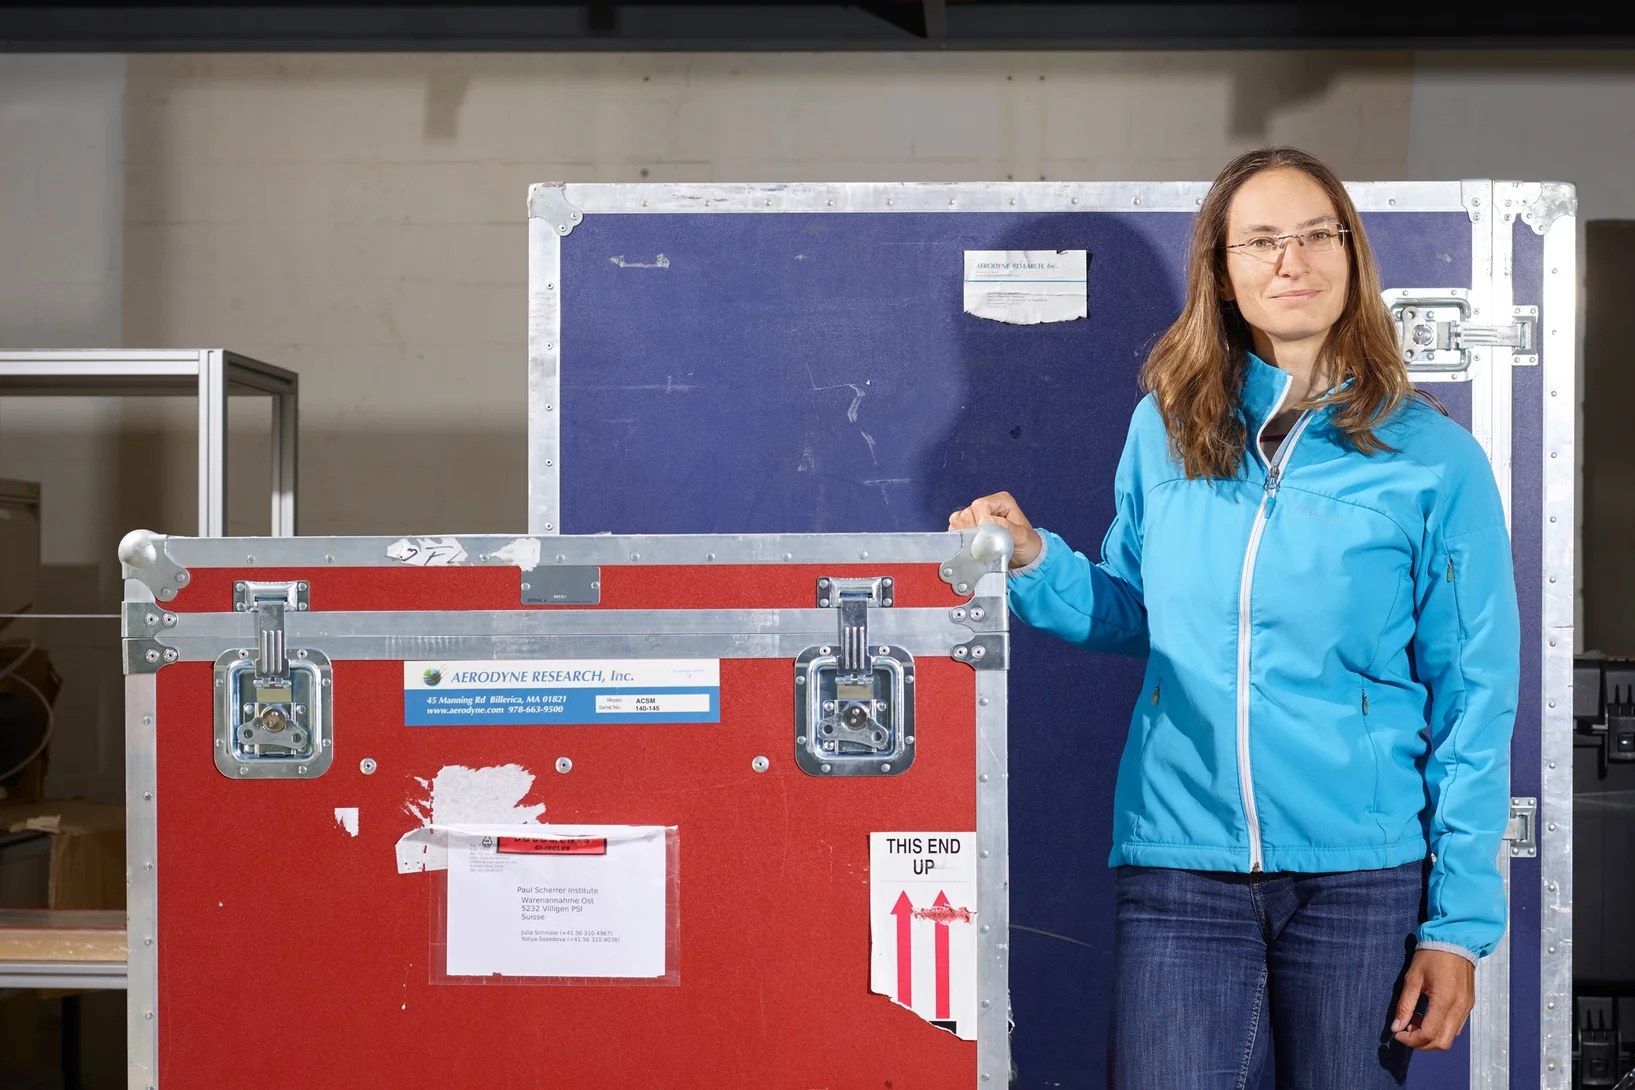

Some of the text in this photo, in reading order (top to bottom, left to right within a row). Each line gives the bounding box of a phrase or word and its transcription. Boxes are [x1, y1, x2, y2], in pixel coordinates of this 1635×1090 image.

[451, 670, 634, 683] AERODYNE RESEARCH, Inc.
[439, 696, 473, 705] Manning
[490, 696, 524, 704] Billerica,
[542, 695, 567, 703] 01821
[427, 707, 504, 715] www.aerodyne.com
[886, 838, 961, 854] THIS END
[913, 859, 935, 875] UP
[542, 905, 569, 913] Villigen
